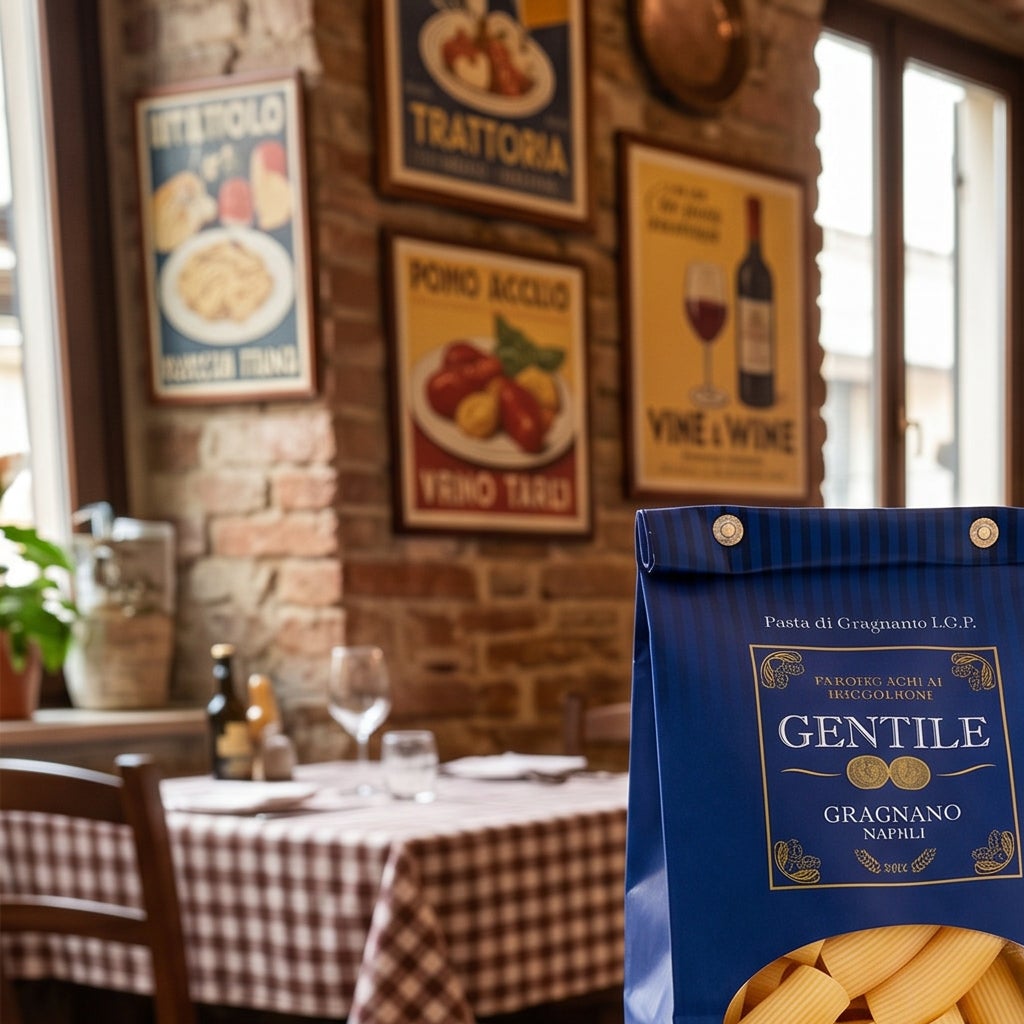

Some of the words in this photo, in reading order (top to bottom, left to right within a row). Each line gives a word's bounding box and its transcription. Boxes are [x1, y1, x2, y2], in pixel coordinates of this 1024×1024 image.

[408, 101, 569, 176] TRATTORIA
[646, 406, 704, 447] VINE
[724, 414, 795, 457] WINE
[765, 616, 811, 629] Pasta
[815, 617, 833, 629] di
[778, 714, 991, 750] GENTILE
[823, 803, 962, 824] GRAGNANO
